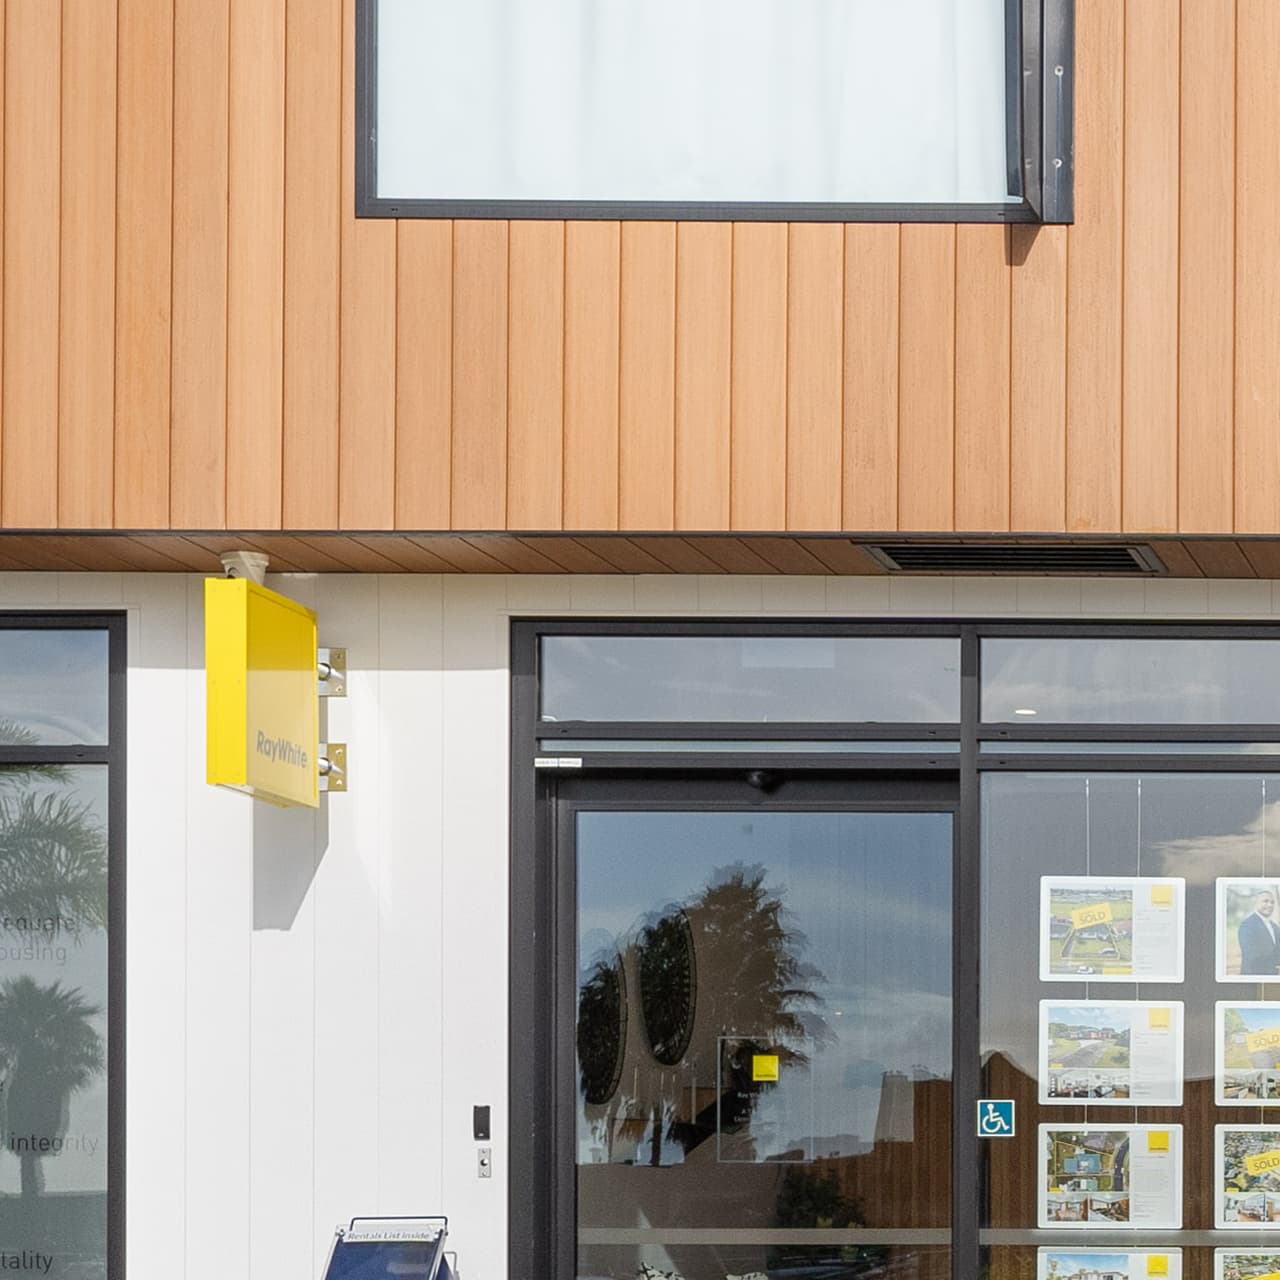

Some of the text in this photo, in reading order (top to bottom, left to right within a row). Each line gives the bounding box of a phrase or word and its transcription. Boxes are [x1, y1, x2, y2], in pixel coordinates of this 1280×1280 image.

[256, 730, 308, 768] RayWhite
[10, 1131, 98, 1156] integrity
[1254, 1158, 1280, 1171] SOLD
